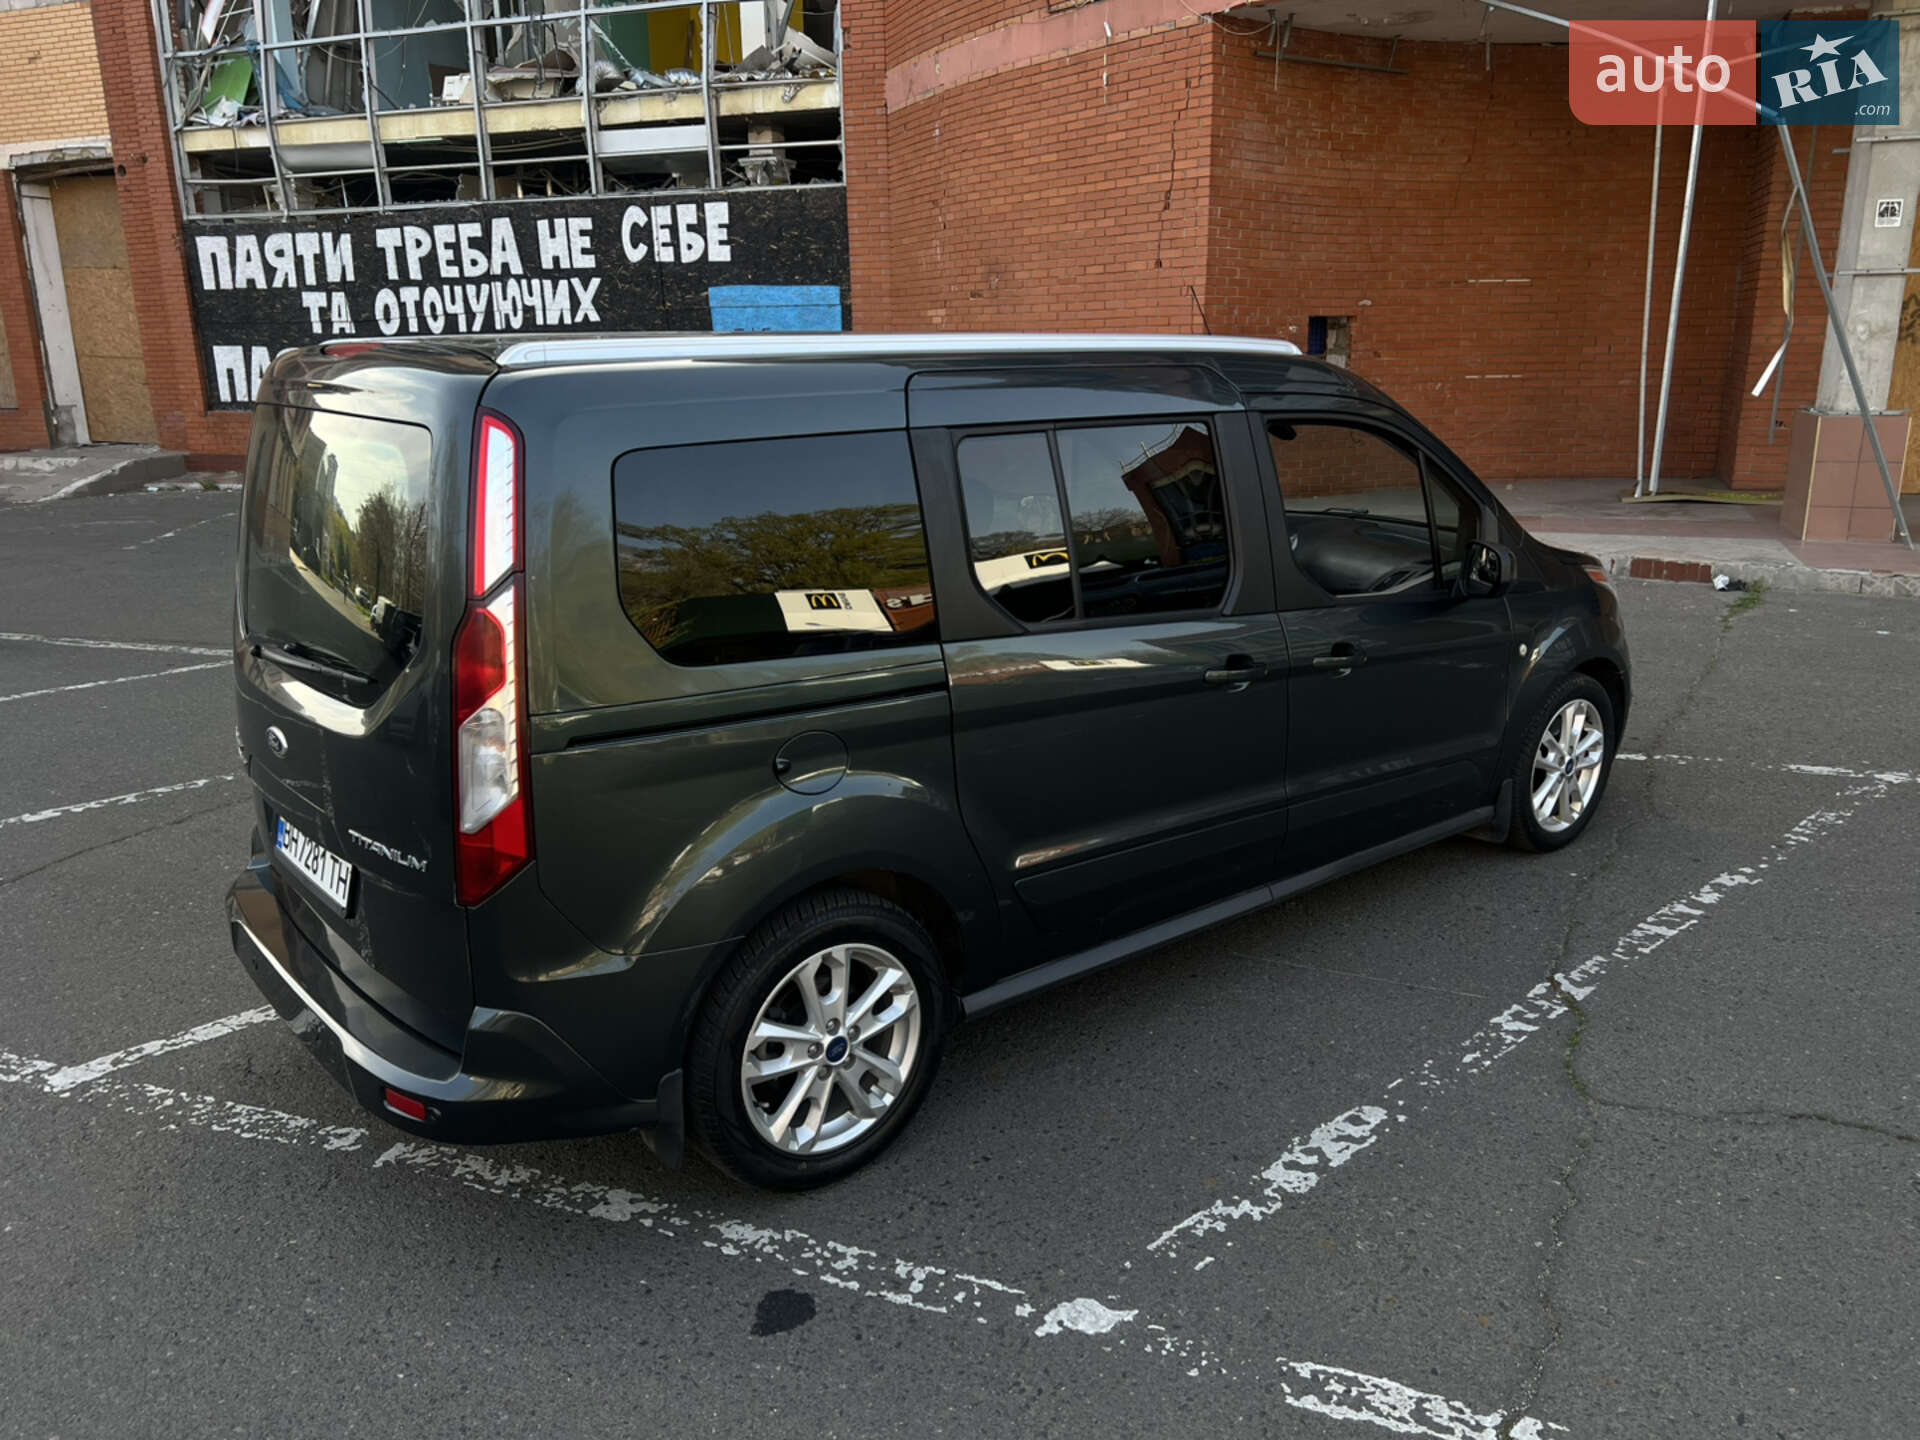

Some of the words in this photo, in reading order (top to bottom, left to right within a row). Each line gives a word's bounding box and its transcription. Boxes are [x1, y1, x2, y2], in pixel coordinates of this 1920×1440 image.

[195, 232, 356, 290] ПАЯТИ
[376, 217, 523, 280] ТРЕБА
[537, 217, 596, 270] НЕ
[622, 202, 731, 263] СЕБЕ
[302, 291, 356, 334] ТА
[375, 278, 600, 335] ОТОЧУЮЧИХ
[348, 829, 428, 872] TITANIUM
